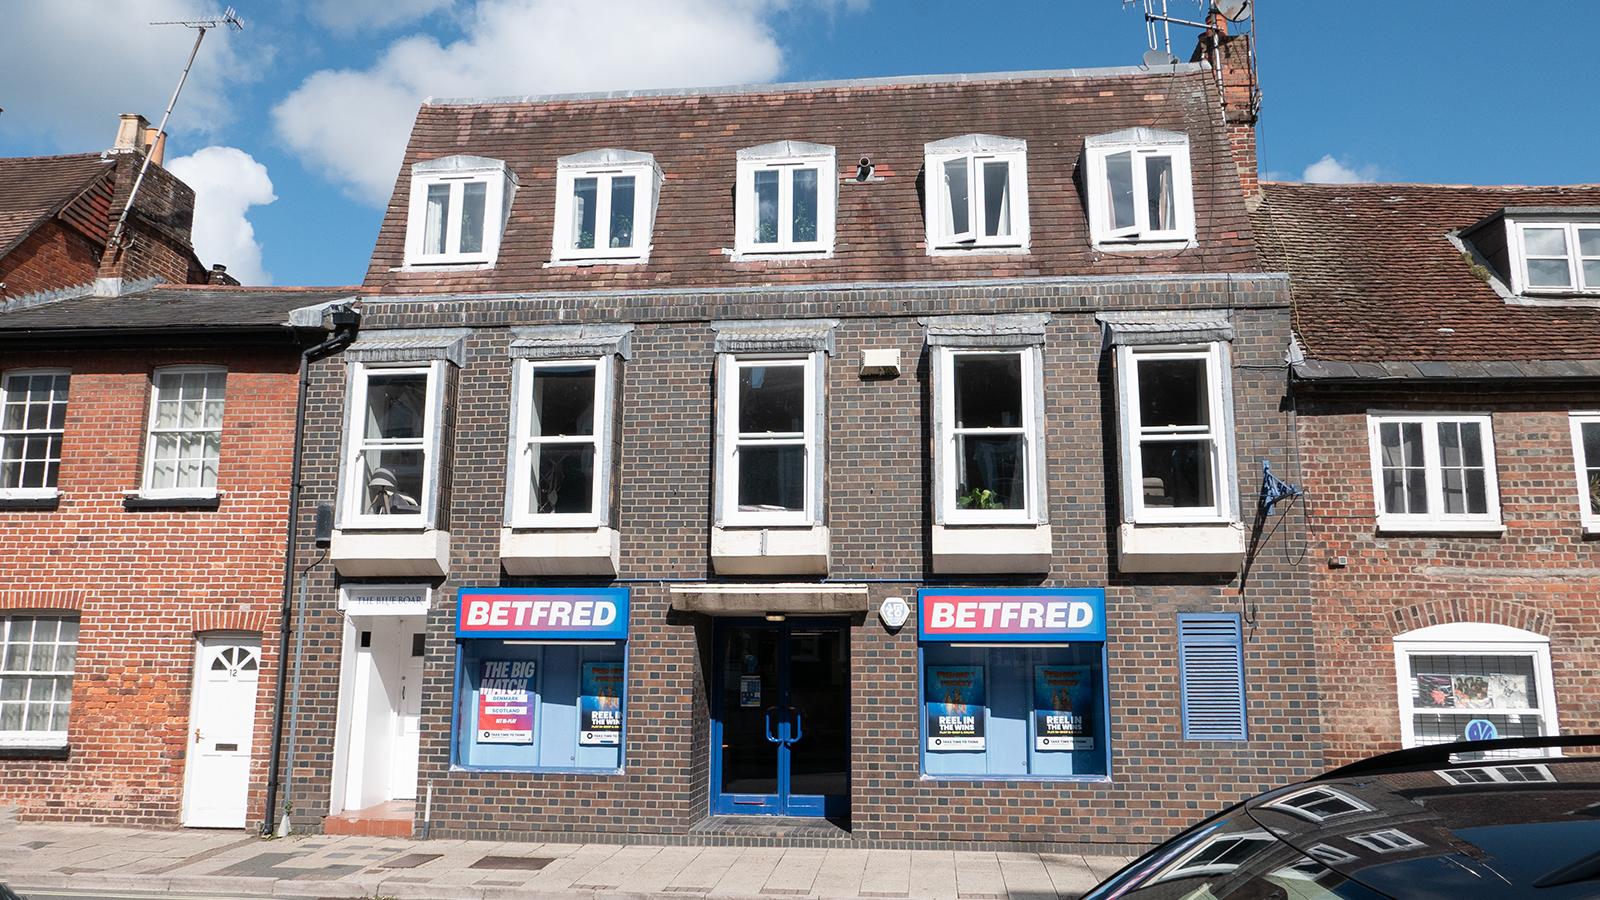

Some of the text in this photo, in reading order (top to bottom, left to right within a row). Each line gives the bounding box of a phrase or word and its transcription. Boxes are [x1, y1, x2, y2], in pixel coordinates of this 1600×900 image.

[358, 596, 423, 605] THE BLUE BOAR
[467, 601, 617, 626] BETFRED
[931, 602, 1094, 628] BETFRED
[229, 669, 238, 677] 12
[485, 661, 536, 679] THE BIG
[480, 679, 528, 695] MATCH
[591, 711, 614, 719] REEL
[939, 716, 975, 724] REEL IN
